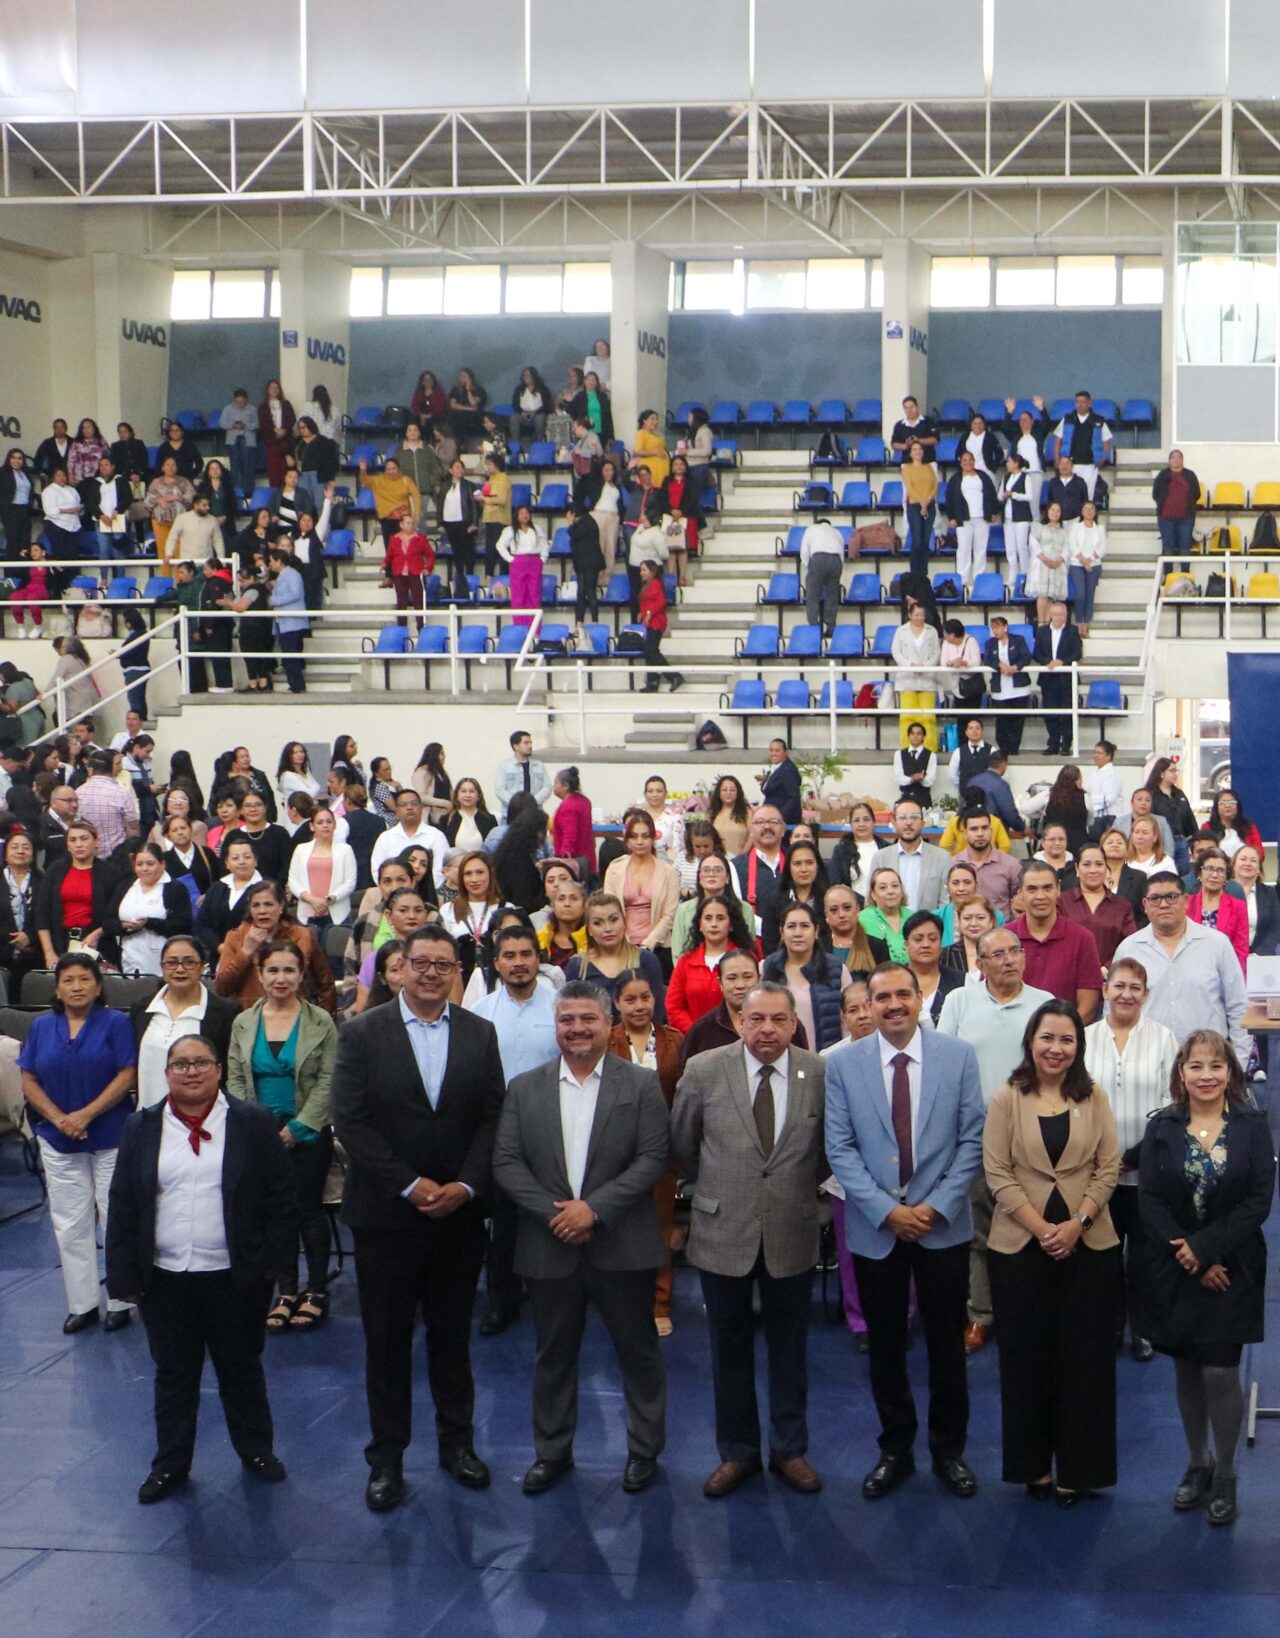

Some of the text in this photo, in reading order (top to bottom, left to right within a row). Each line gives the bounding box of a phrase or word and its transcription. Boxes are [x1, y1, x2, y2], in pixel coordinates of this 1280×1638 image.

[122, 318, 166, 347] UVAQ
[638, 329, 665, 358] UVAQ
[307, 336, 346, 366] UVAQ
